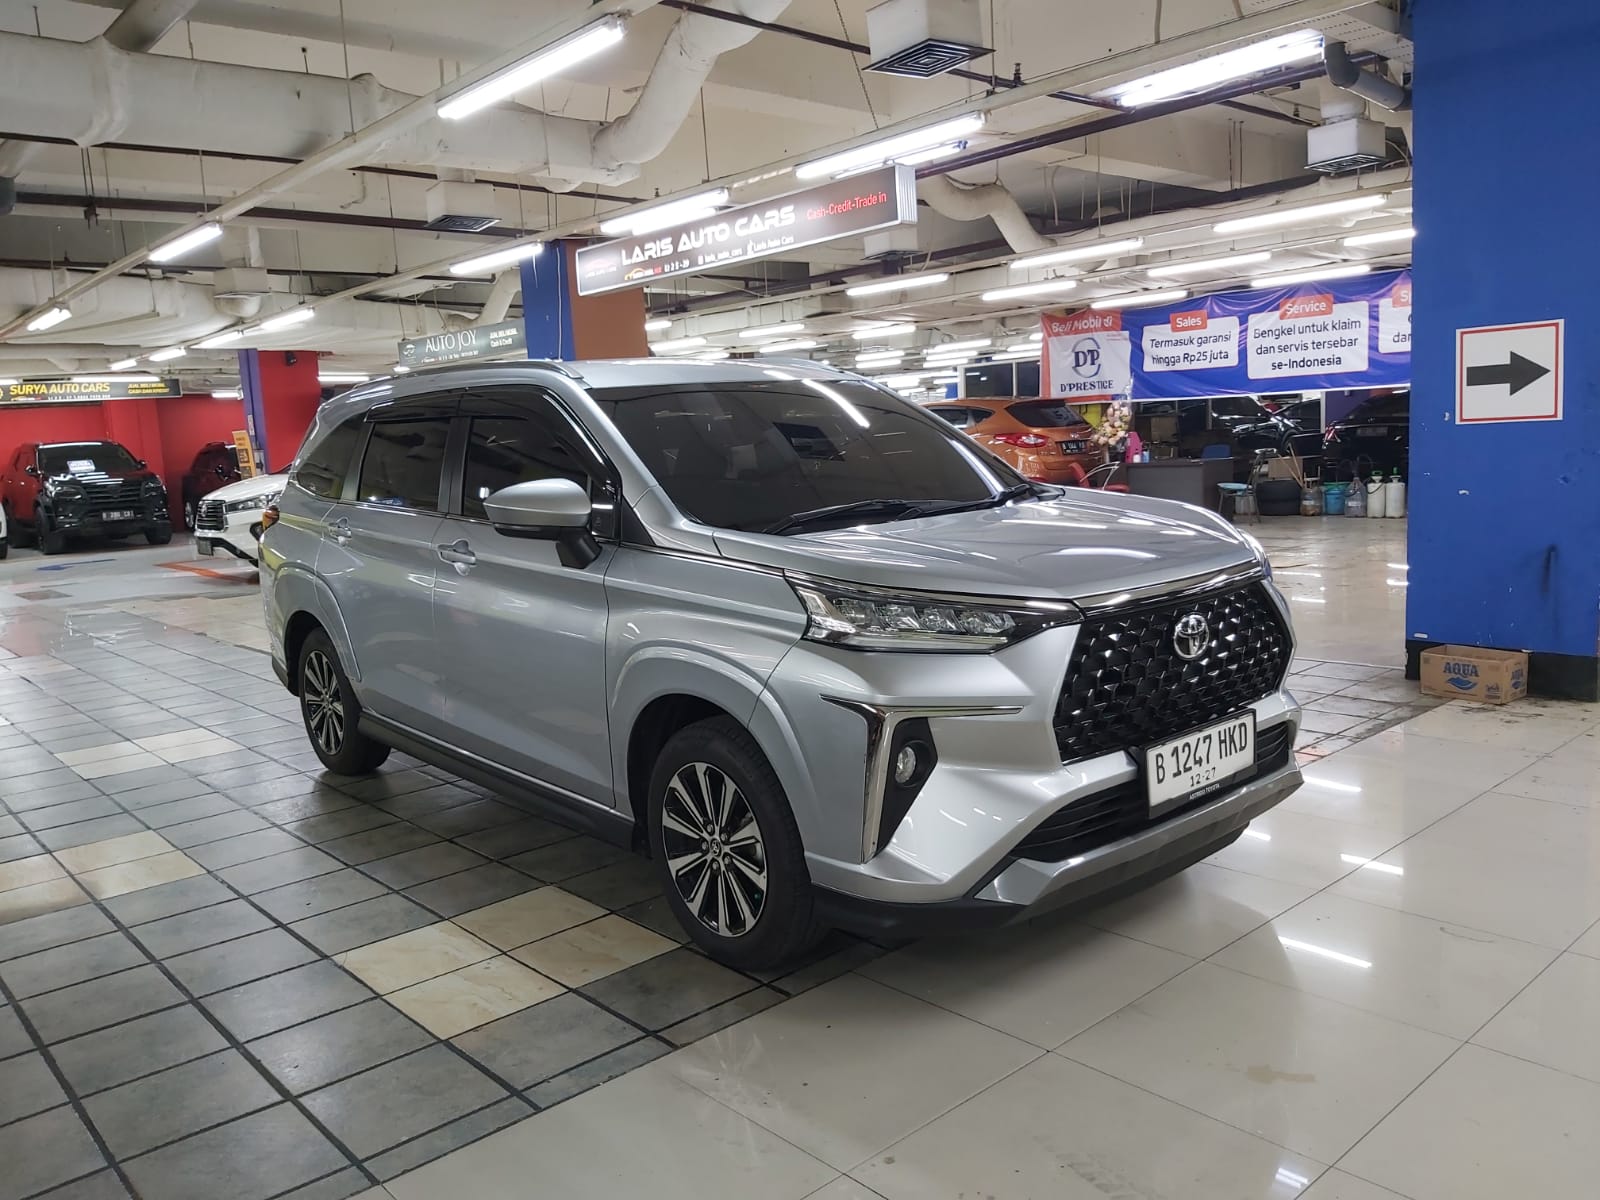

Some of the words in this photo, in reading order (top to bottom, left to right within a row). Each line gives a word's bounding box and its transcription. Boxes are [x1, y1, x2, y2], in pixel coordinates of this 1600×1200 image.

[806, 193, 878, 220] Cash-Credit-Trade
[878, 191, 887, 203] in
[621, 237, 673, 266] LARIS
[677, 222, 730, 252] AUTO
[734, 205, 796, 237] CARS
[1286, 301, 1327, 315] Service
[1051, 320, 1073, 333] Beli
[1072, 316, 1102, 331] Mobil
[1103, 315, 1113, 327] di
[1176, 316, 1202, 328] Sales
[1253, 324, 1296, 340] Bengkel
[1297, 321, 1330, 334] untuk
[1331, 318, 1361, 331] klaim
[425, 334, 456, 353] AUTO
[457, 329, 477, 351] JOY
[1149, 335, 1195, 349] Termasuk
[1196, 331, 1232, 347] garansi
[1255, 344, 1276, 355] dan
[1277, 340, 1309, 353] servis
[1311, 337, 1359, 350] tersebar
[1151, 354, 1181, 367] hingga
[1182, 351, 1208, 365] Rp25
[1208, 350, 1229, 363] juta
[1271, 354, 1342, 371] se-Indonesia
[9, 383, 48, 396] SURYA
[49, 383, 80, 394] AUTO
[81, 382, 111, 393] CARS
[1060, 380, 1114, 393] D'PRESTIGE
[1443, 661, 1480, 678] AQUA
[1155, 752, 1166, 785] B
[1171, 733, 1212, 778] 1247
[1217, 722, 1248, 760] HKD
